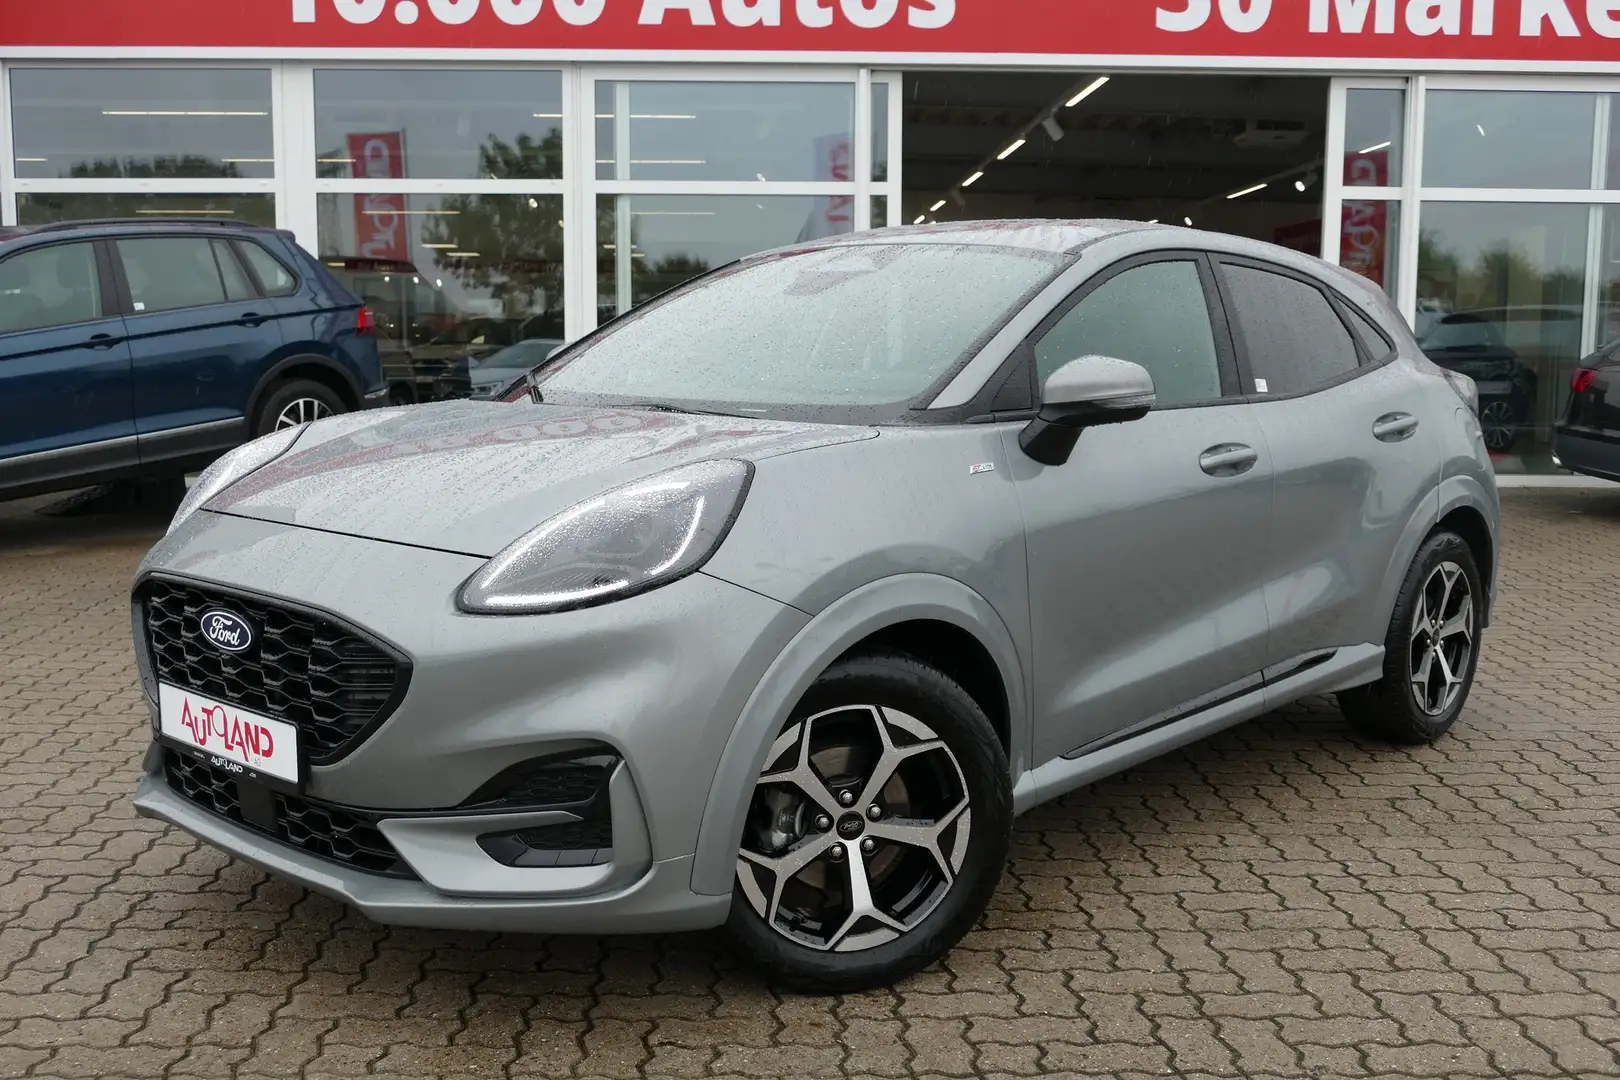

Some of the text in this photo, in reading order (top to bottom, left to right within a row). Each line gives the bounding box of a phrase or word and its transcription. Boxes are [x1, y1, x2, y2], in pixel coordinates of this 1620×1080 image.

[210, 616, 240, 645] Ford
[181, 696, 274, 762] AUTOLAND
[211, 756, 243, 772] AUTOLAND
